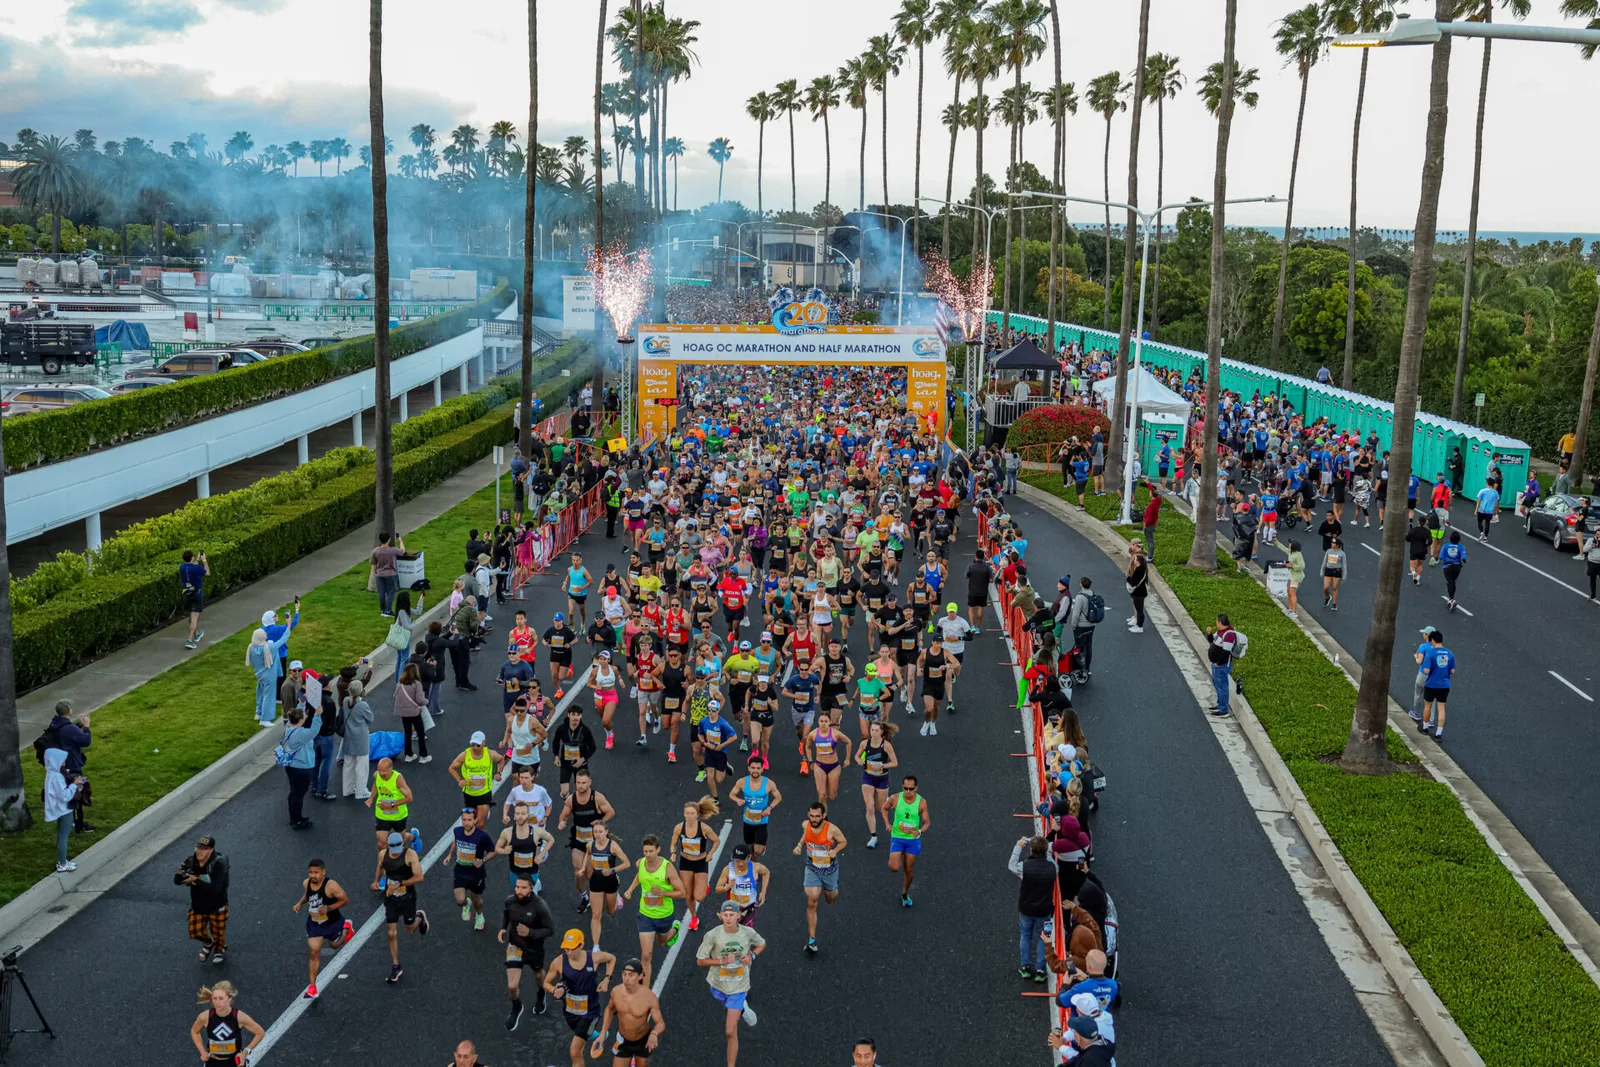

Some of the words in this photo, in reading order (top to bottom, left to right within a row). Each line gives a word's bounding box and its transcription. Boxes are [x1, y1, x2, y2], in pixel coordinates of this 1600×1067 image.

[786, 301, 828, 324] 20
[780, 326, 825, 336] marathon
[682, 343, 714, 352] HOAG
[716, 343, 733, 352] OC
[735, 343, 792, 353] MARATHON
[794, 344, 816, 353] AND
[818, 344, 842, 353] HALF
[844, 344, 901, 353] MARATHON
